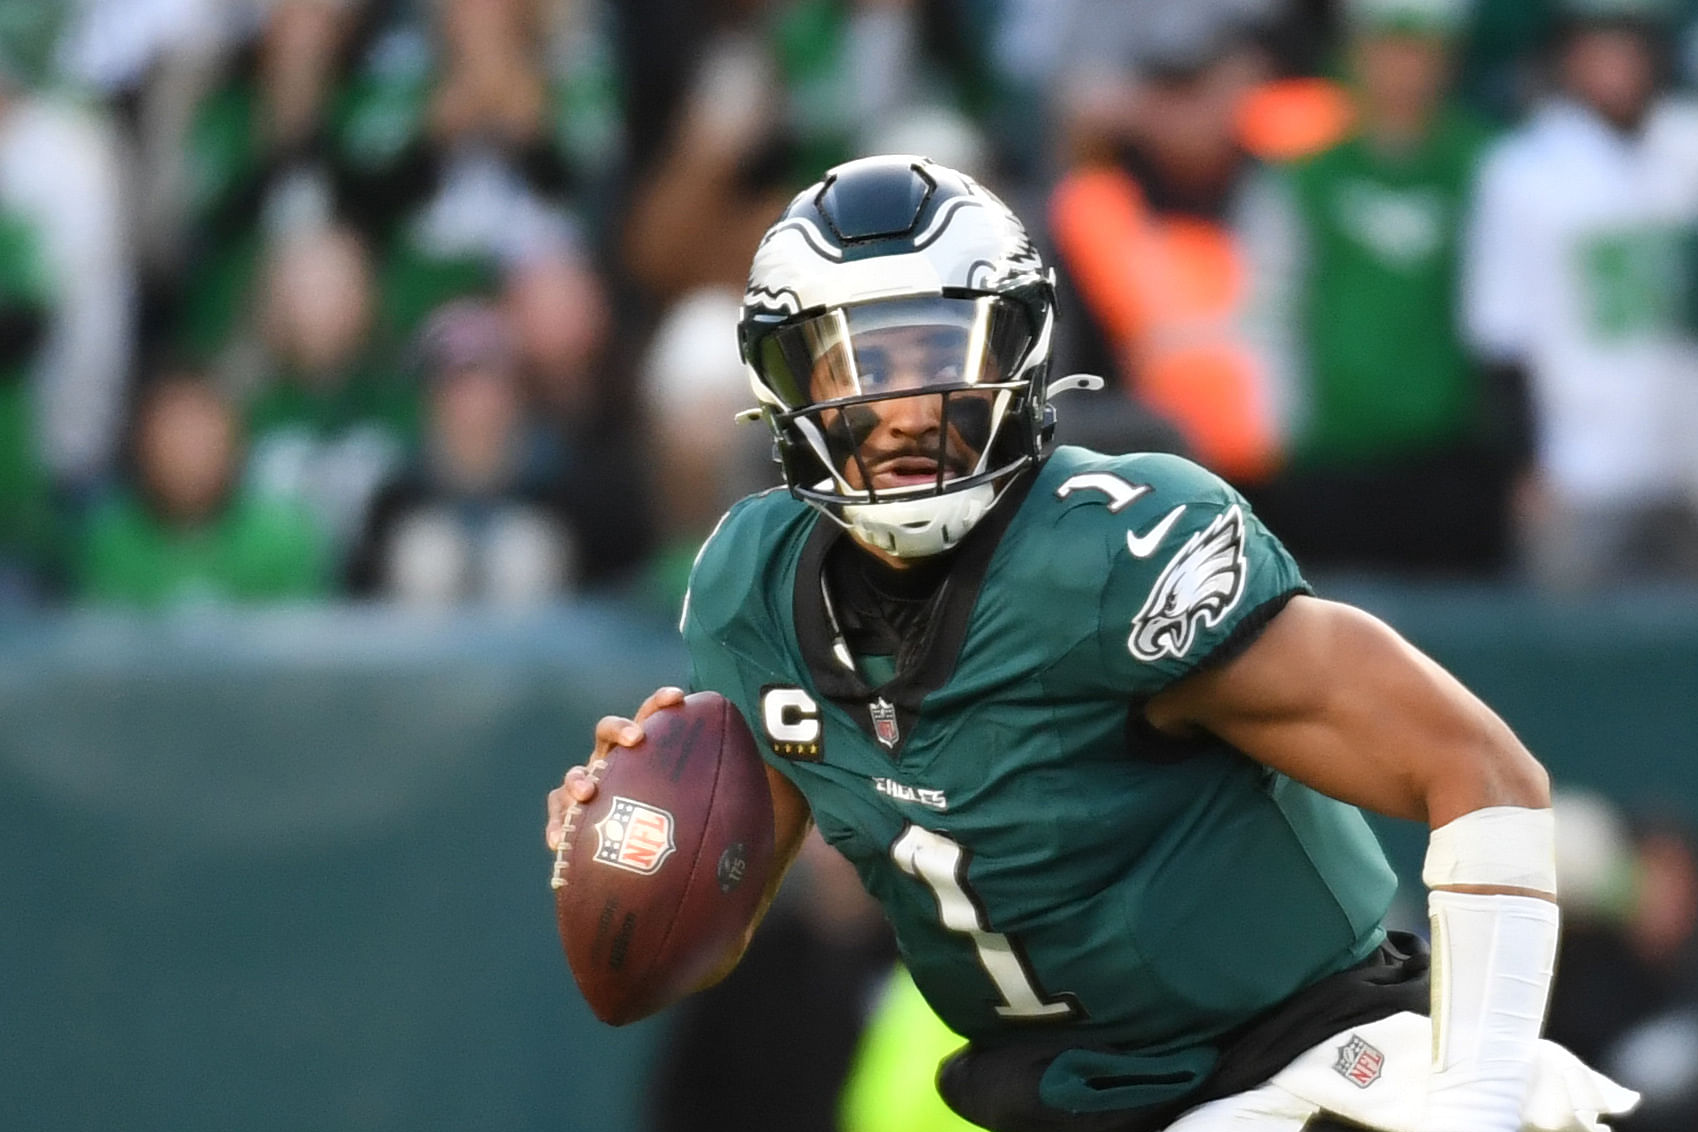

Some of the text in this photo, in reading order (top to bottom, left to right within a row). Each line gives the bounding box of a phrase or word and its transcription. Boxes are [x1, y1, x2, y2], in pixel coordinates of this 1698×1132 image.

[1053, 469, 1154, 514] 1
[764, 688, 820, 742] C
[621, 815, 666, 868] NFL
[891, 822, 1084, 1020] 1
[1349, 1049, 1383, 1085] NFL
